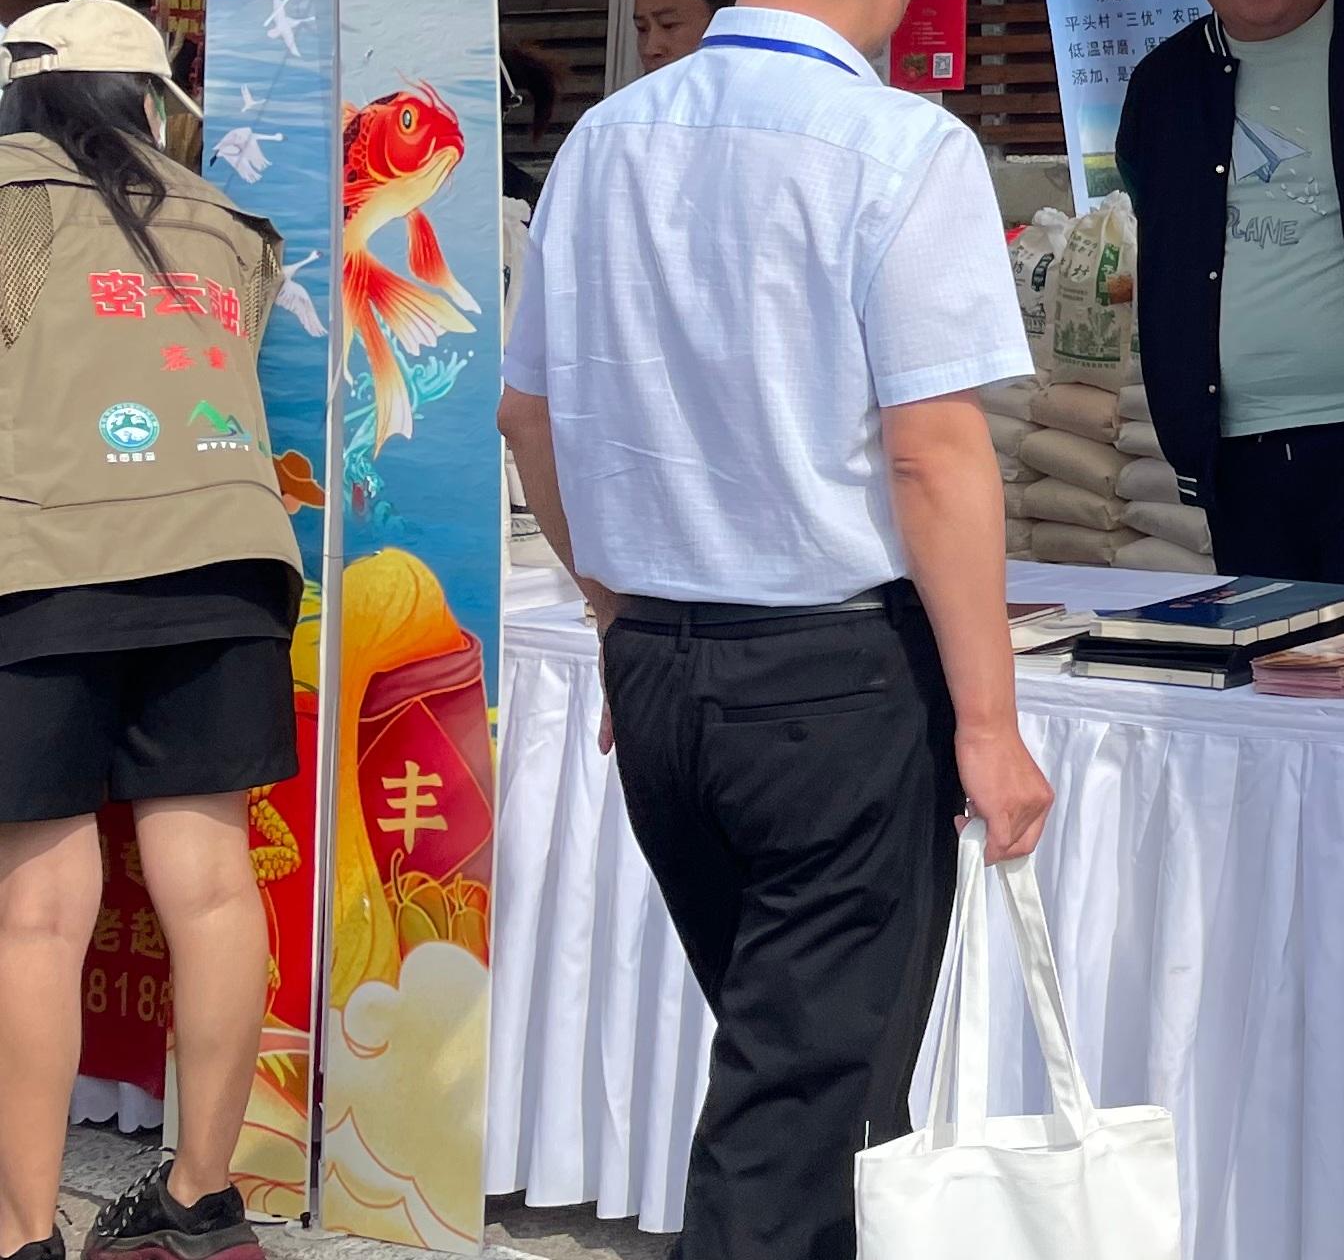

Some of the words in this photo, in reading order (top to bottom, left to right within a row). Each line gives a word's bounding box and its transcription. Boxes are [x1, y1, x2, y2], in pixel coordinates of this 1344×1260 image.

[88, 270, 249, 340] 密云融
[377, 760, 448, 854] 丰
